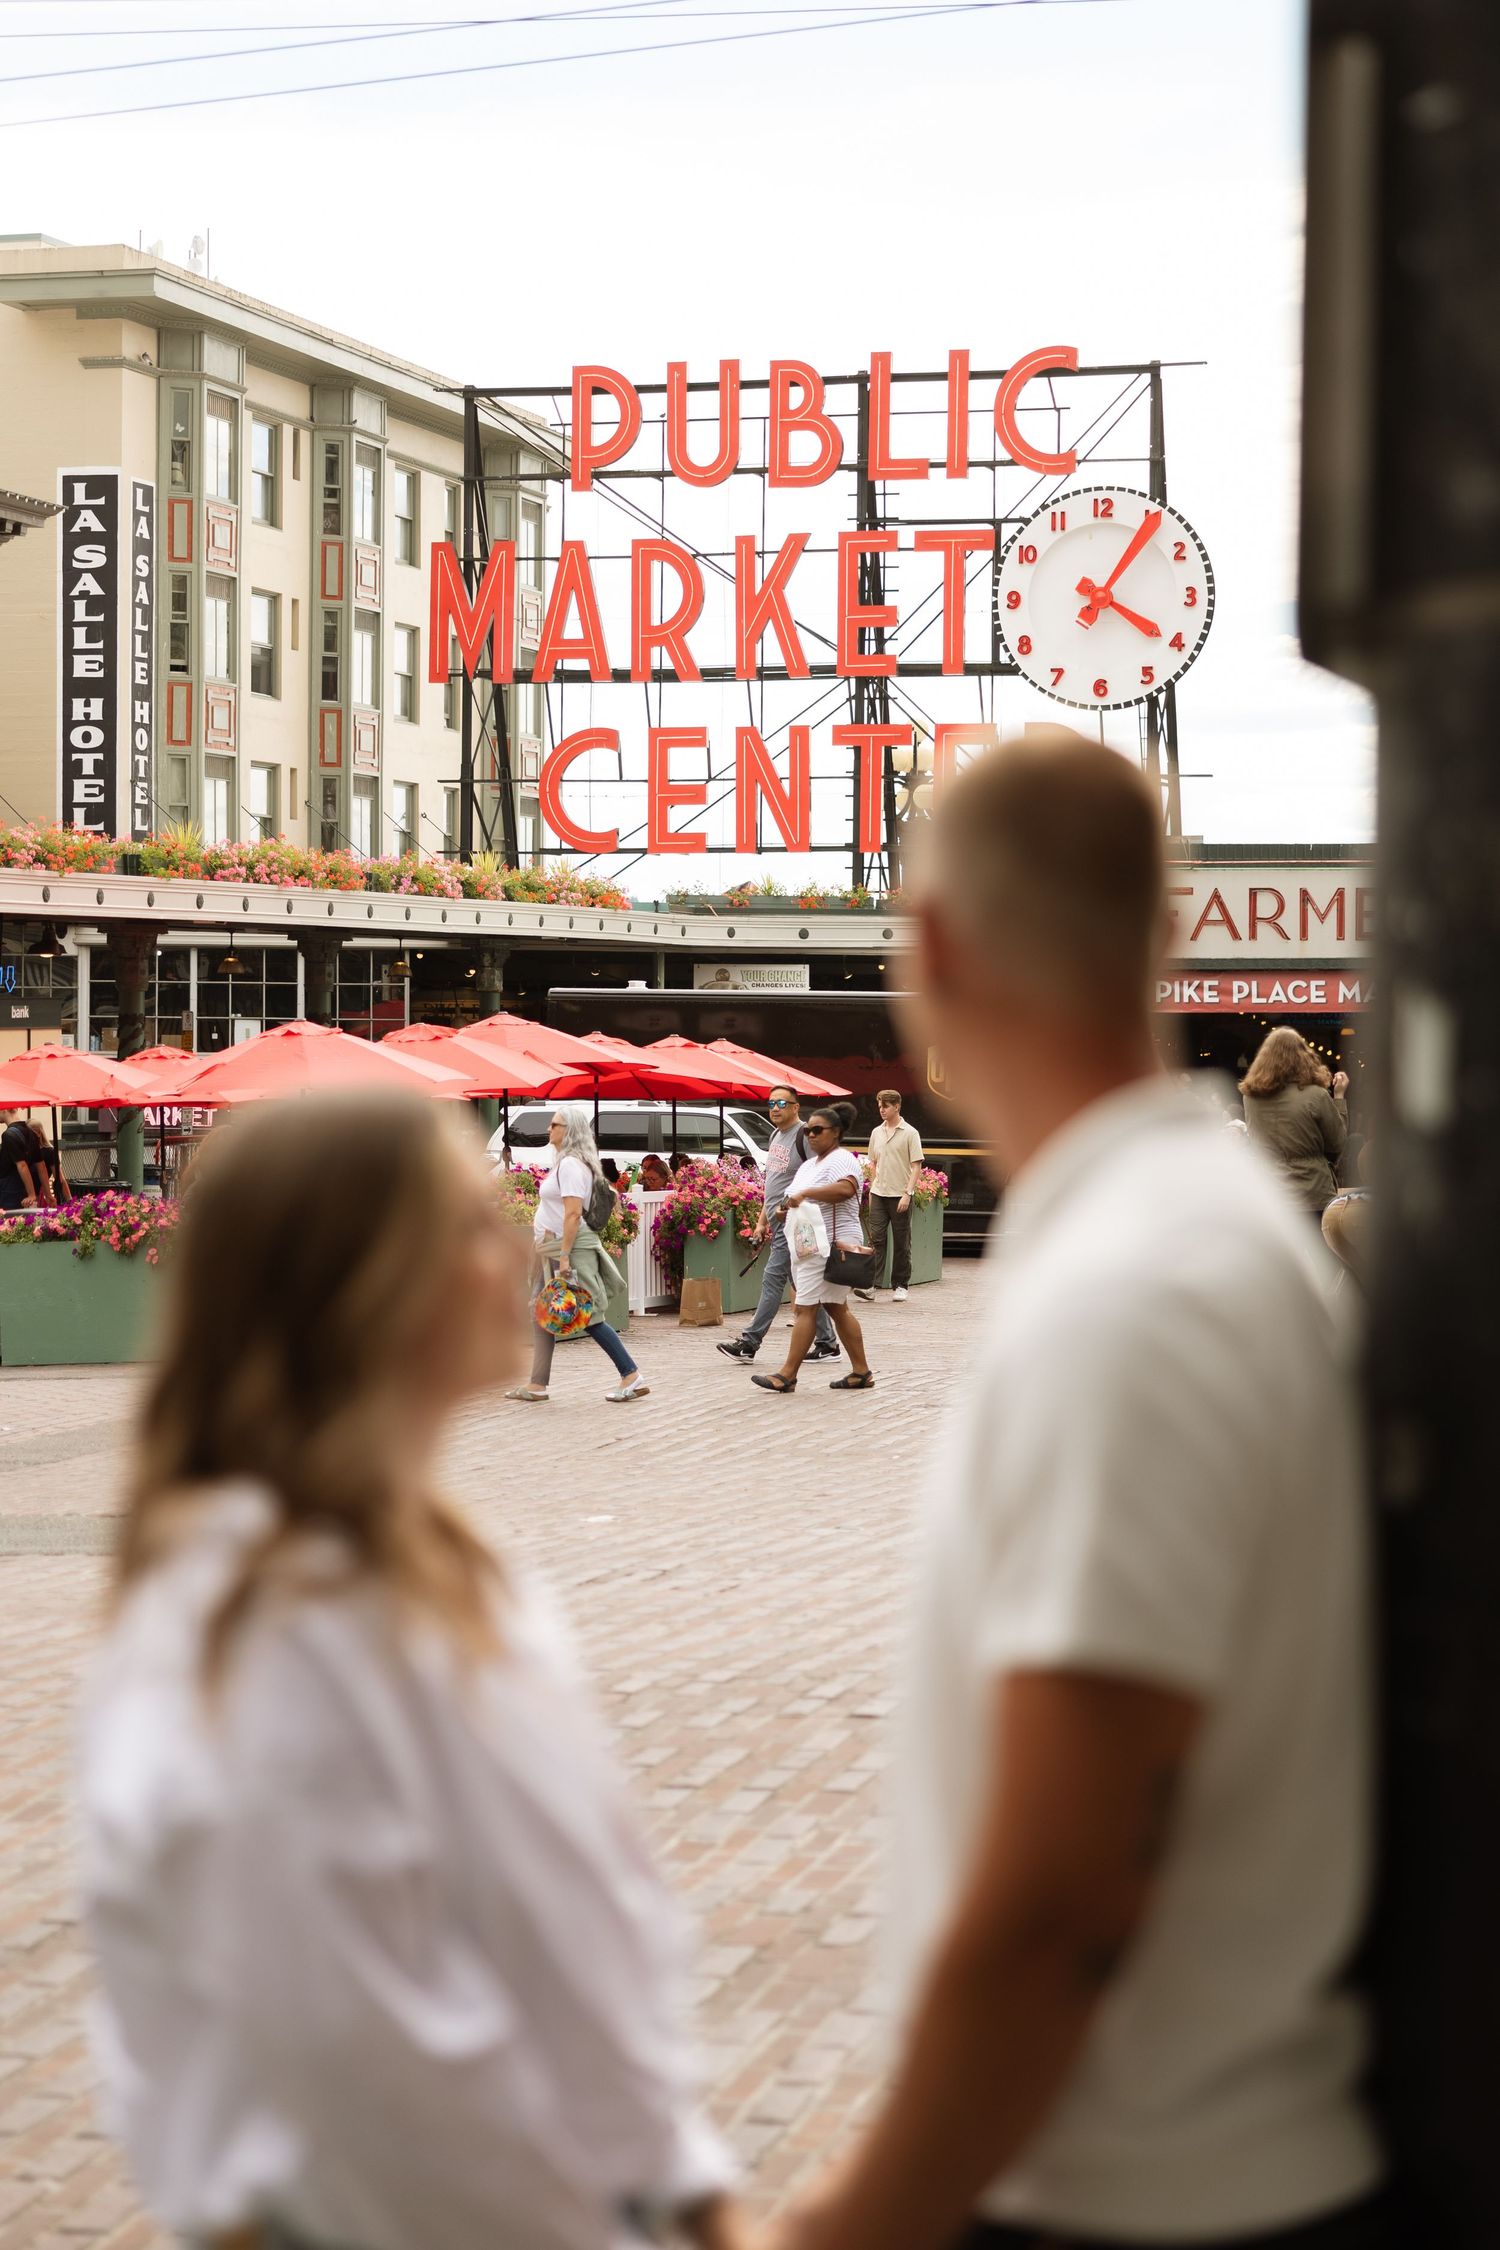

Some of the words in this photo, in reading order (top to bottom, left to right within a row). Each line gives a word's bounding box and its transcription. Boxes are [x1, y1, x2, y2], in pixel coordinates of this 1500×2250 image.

[571, 345, 1079, 492] PUBLIC
[69, 482, 107, 532] LA
[135, 487, 150, 539] LA
[1093, 498, 1113, 517] 12
[1051, 511, 1066, 531] 11
[1018, 545, 1037, 564] 10
[1173, 541, 1186, 560] 2
[428, 529, 997, 684] MARKET
[1006, 590, 1021, 609] 9
[1183, 586, 1197, 607] 3
[68, 544, 107, 678] SALLE
[134, 554, 150, 685] SALLE
[1017, 635, 1032, 655] 8
[1168, 632, 1185, 651] 4
[1050, 667, 1064, 686] 7
[1140, 666, 1154, 685] 5
[1093, 678, 1108, 697] 6
[69, 697, 105, 831] HOTEL
[134, 700, 150, 831] HOTEL
[538, 722, 1084, 854] CENT
[740, 970, 766, 982] YOUR
[767, 970, 806, 982] CHANGE
[1156, 980, 1220, 1003] PIKE
[1232, 980, 1327, 1004] PLACE
[11, 1005, 29, 1019] bank
[143, 1106, 218, 1127] ARKET
